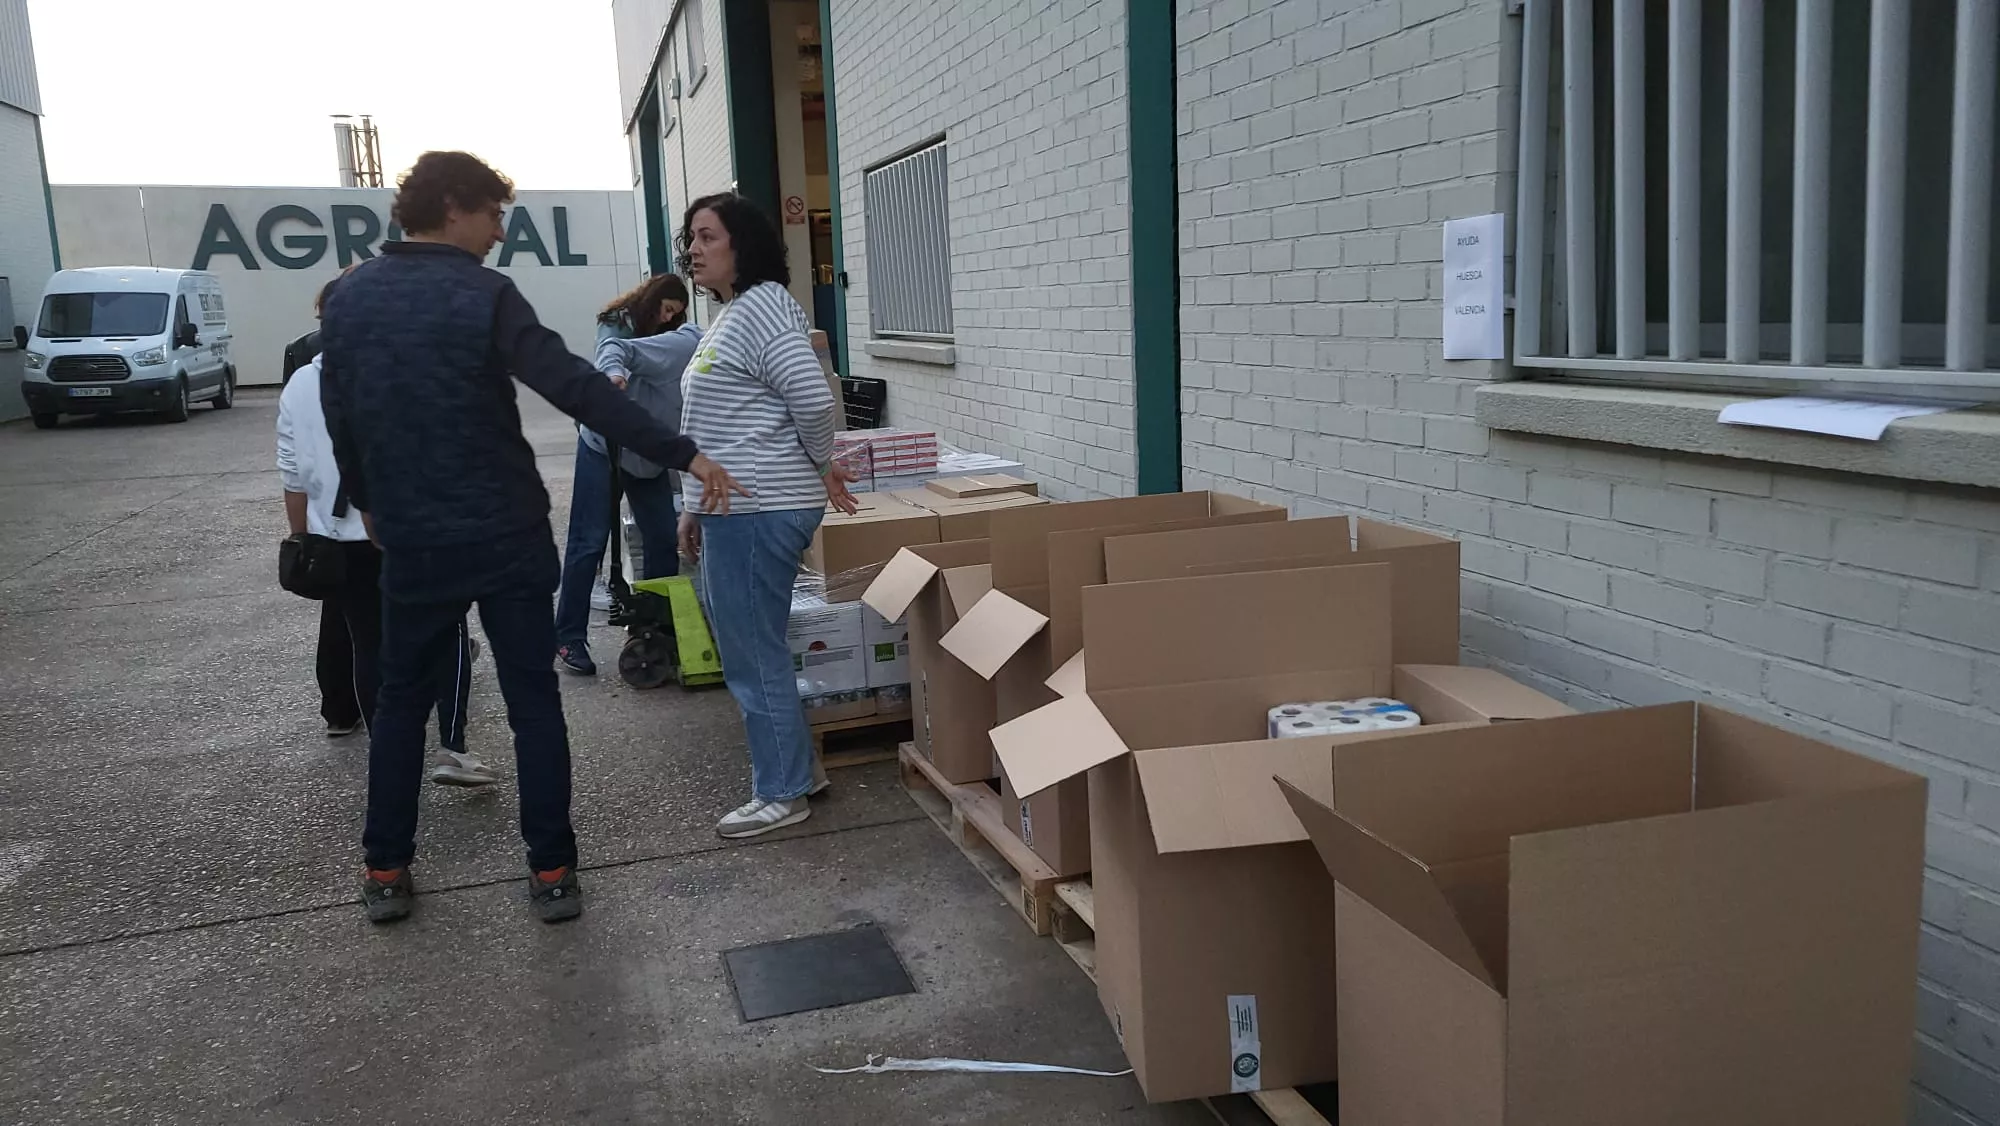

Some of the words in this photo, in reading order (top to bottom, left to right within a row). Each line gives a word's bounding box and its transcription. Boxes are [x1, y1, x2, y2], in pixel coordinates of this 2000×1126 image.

[190, 203, 588, 270] AGRAL
[1457, 235, 1480, 247] AYUDA
[1456, 270, 1484, 281] HUESCA
[1454, 304, 1486, 315] VALENCIA
